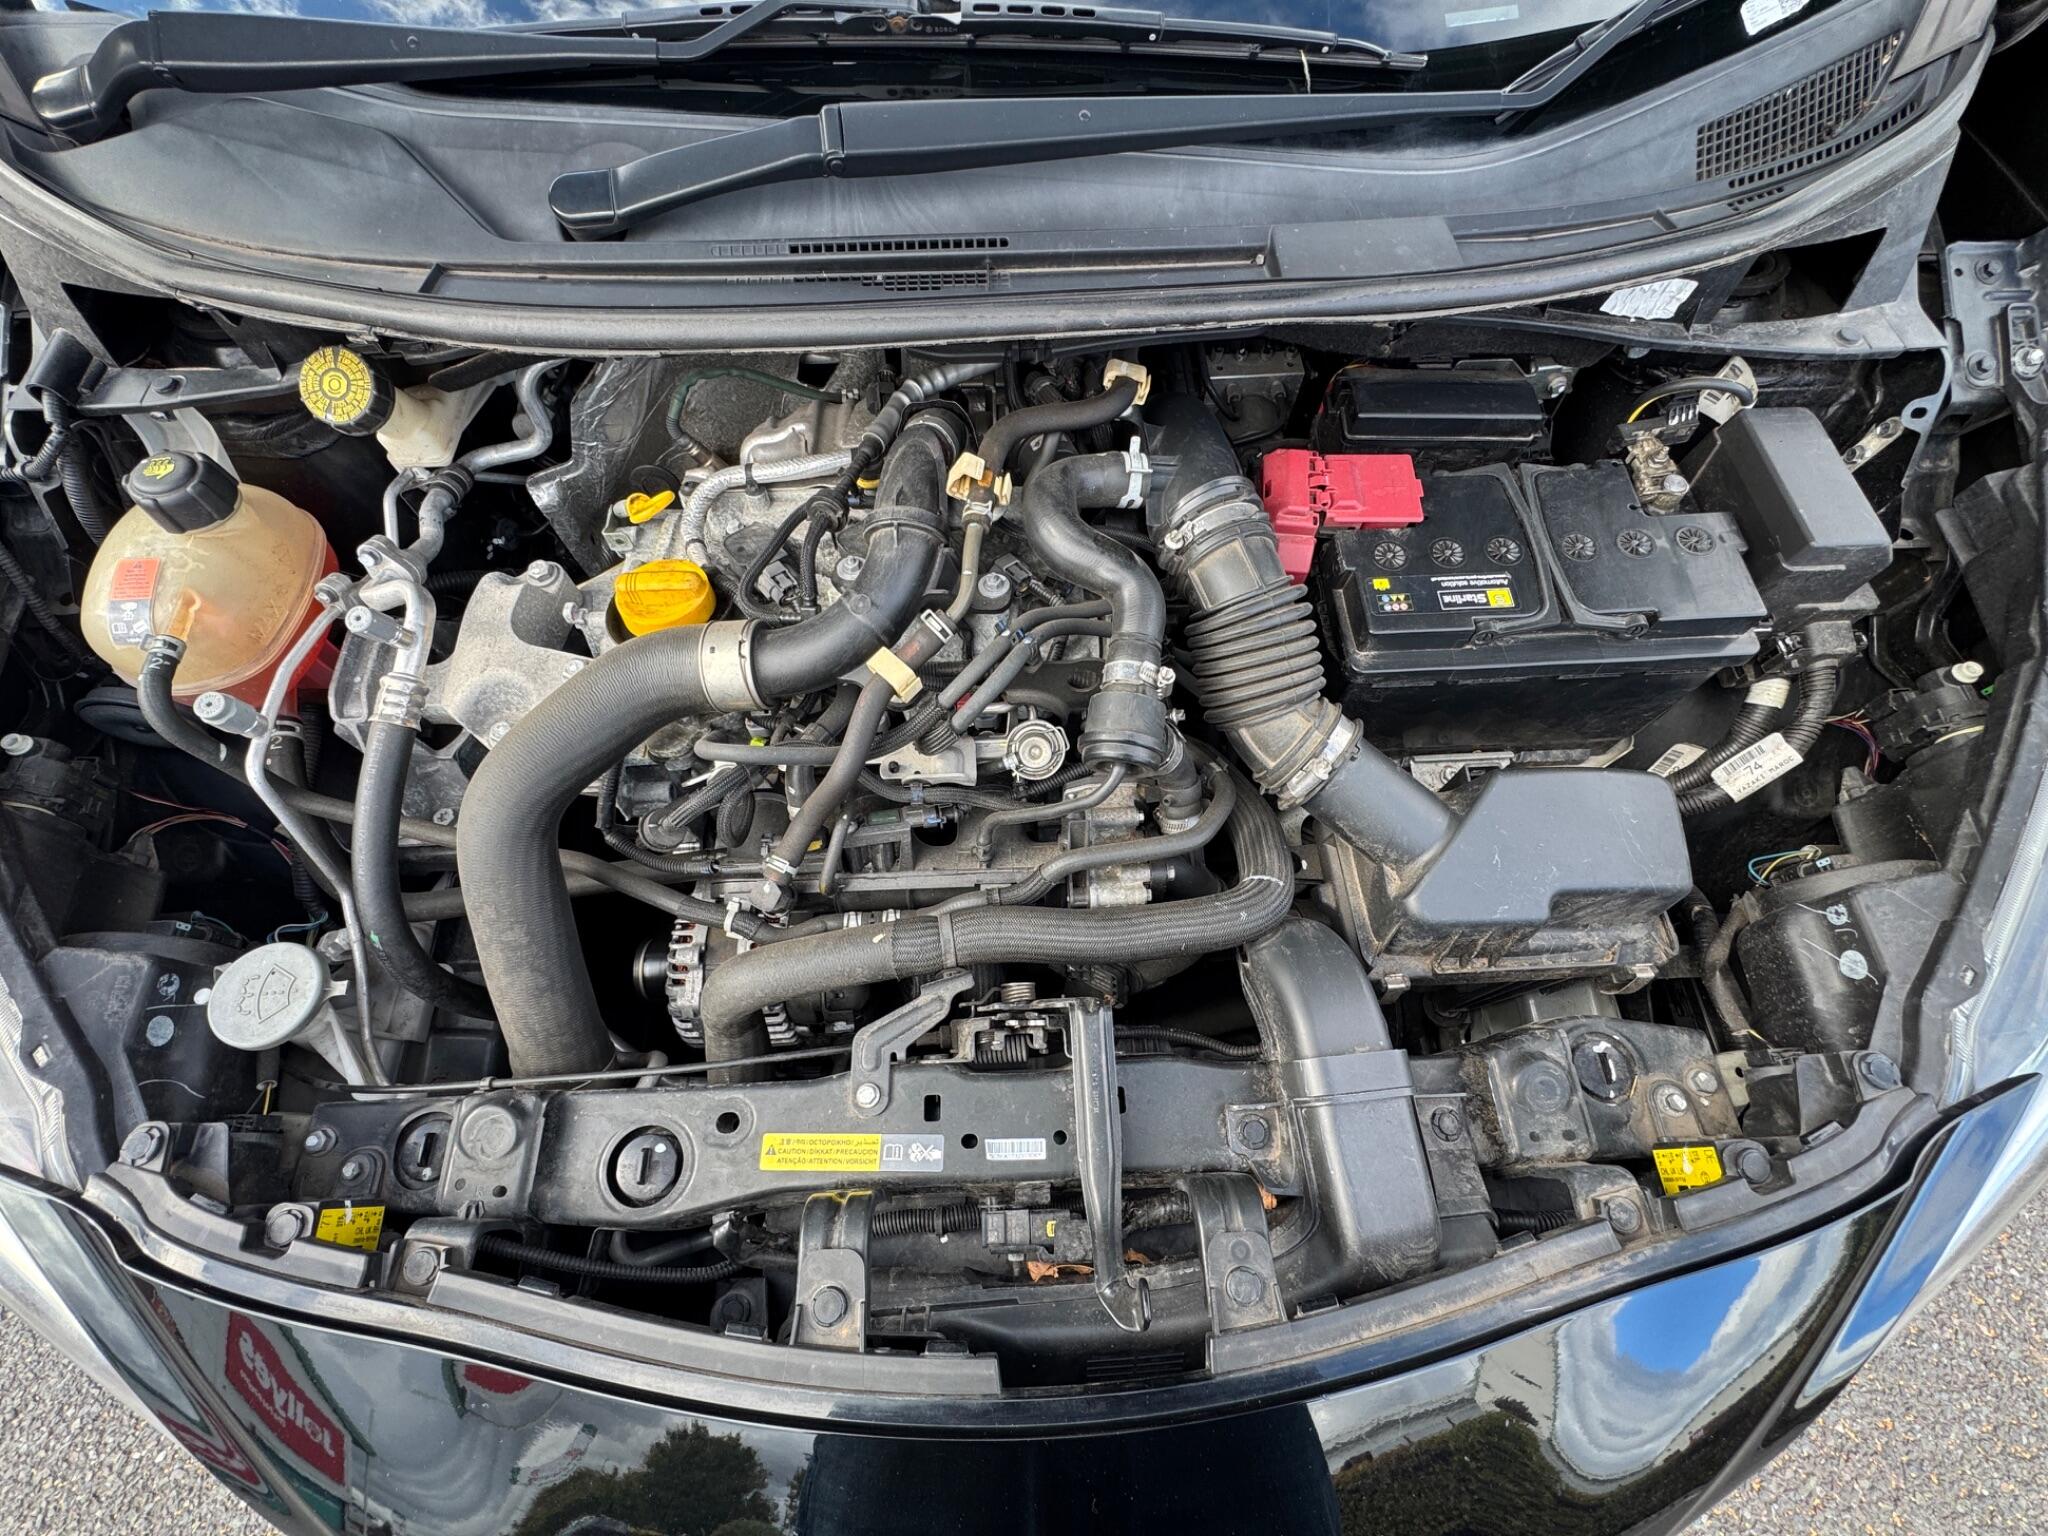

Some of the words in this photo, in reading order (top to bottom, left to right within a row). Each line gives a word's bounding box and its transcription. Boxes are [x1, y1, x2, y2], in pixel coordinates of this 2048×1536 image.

[1442, 593, 1487, 604] Starline
[1737, 774, 1766, 793] YAZAKI
[1768, 755, 1794, 774] MAROC
[1742, 761, 1763, 775] 74
